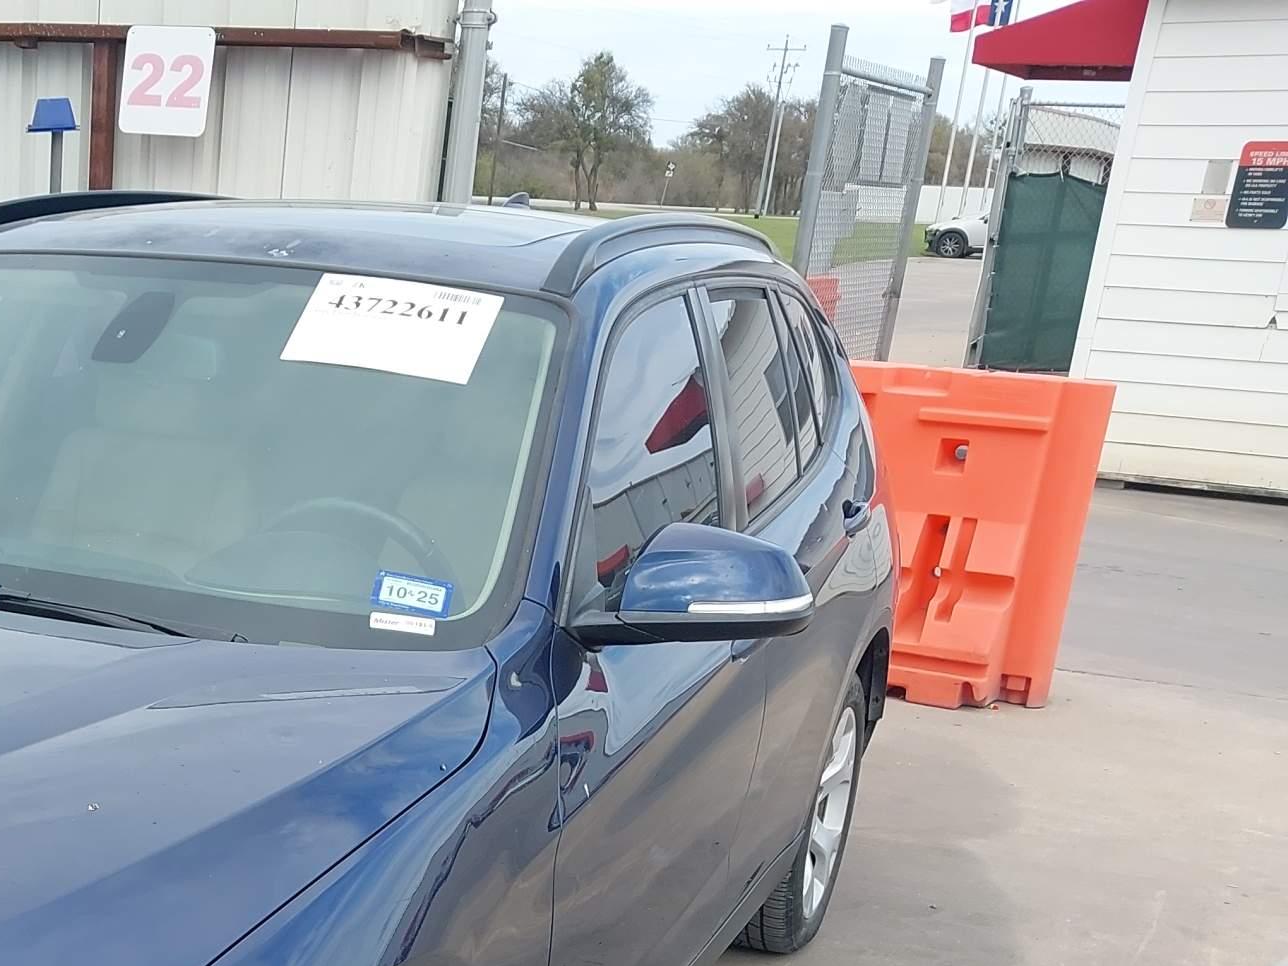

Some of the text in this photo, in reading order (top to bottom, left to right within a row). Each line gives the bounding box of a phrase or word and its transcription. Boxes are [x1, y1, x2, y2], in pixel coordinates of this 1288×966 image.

[127, 53, 205, 109] 22
[1252, 158, 1288, 166] 15 MPH
[328, 294, 468, 325] 43722611
[386, 584, 408, 599] 10
[416, 590, 440, 606] 25
